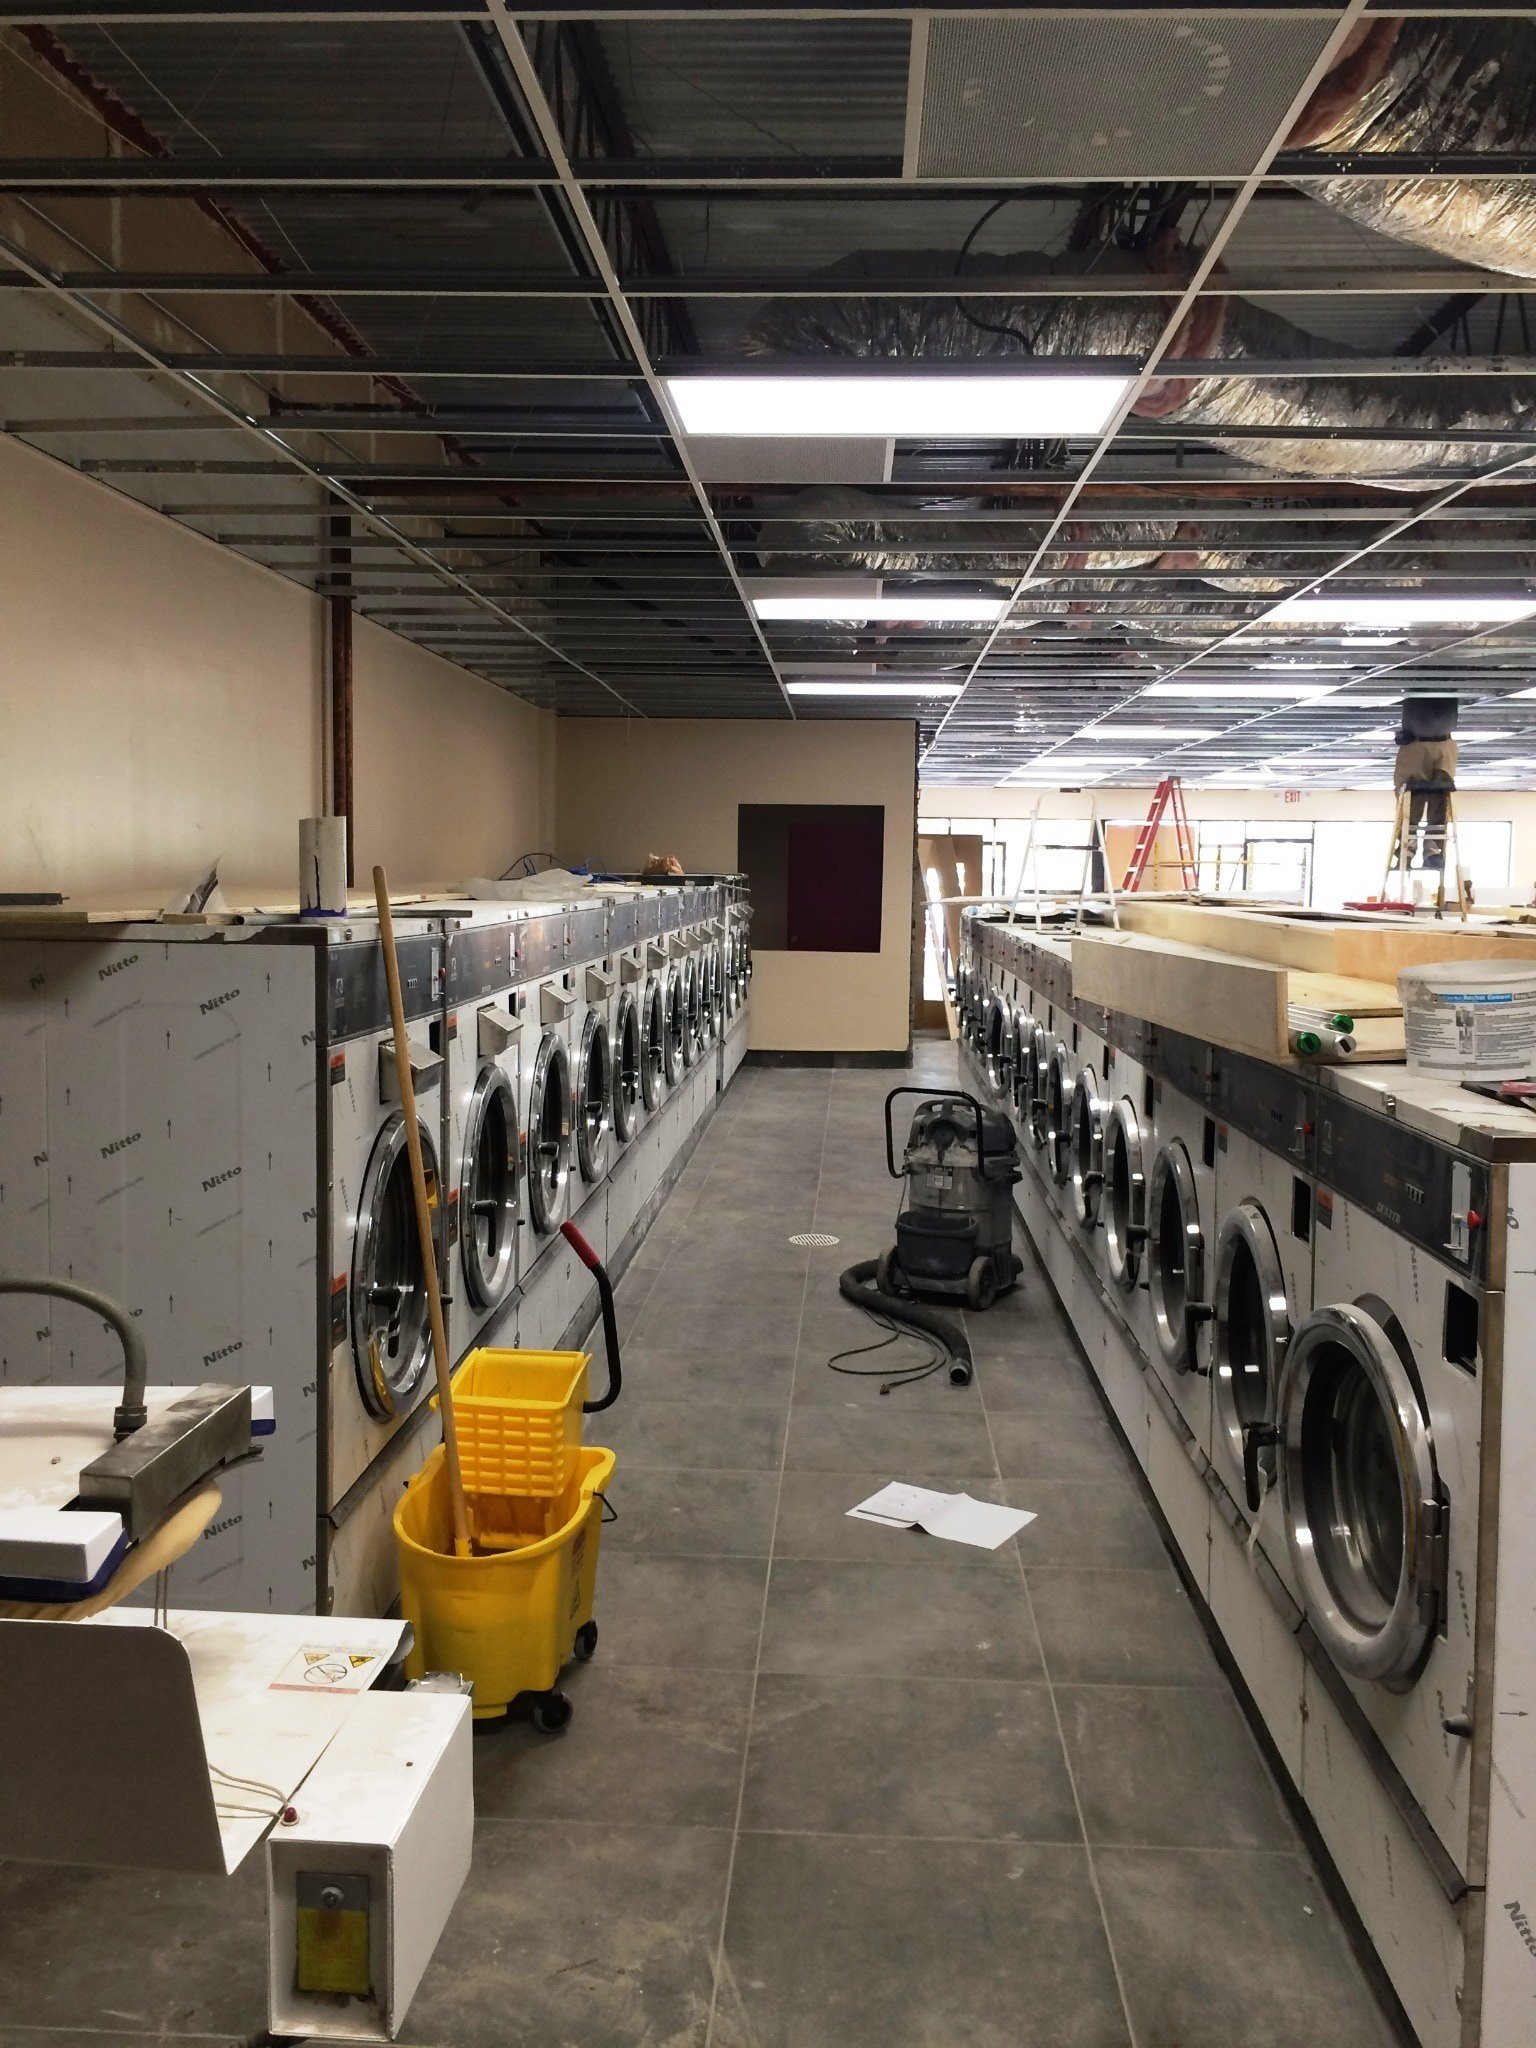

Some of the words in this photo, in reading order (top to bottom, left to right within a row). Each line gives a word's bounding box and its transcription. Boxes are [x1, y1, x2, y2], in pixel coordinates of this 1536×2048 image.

[1285, 790, 1301, 803] EXIT
[98, 953, 139, 981] Nitto
[199, 989, 241, 1015] Nitto
[100, 1132, 142, 1159] Nitto
[201, 1166, 242, 1192] Nitto
[202, 1341, 243, 1367] Nitto
[203, 1515, 243, 1540] Nitto
